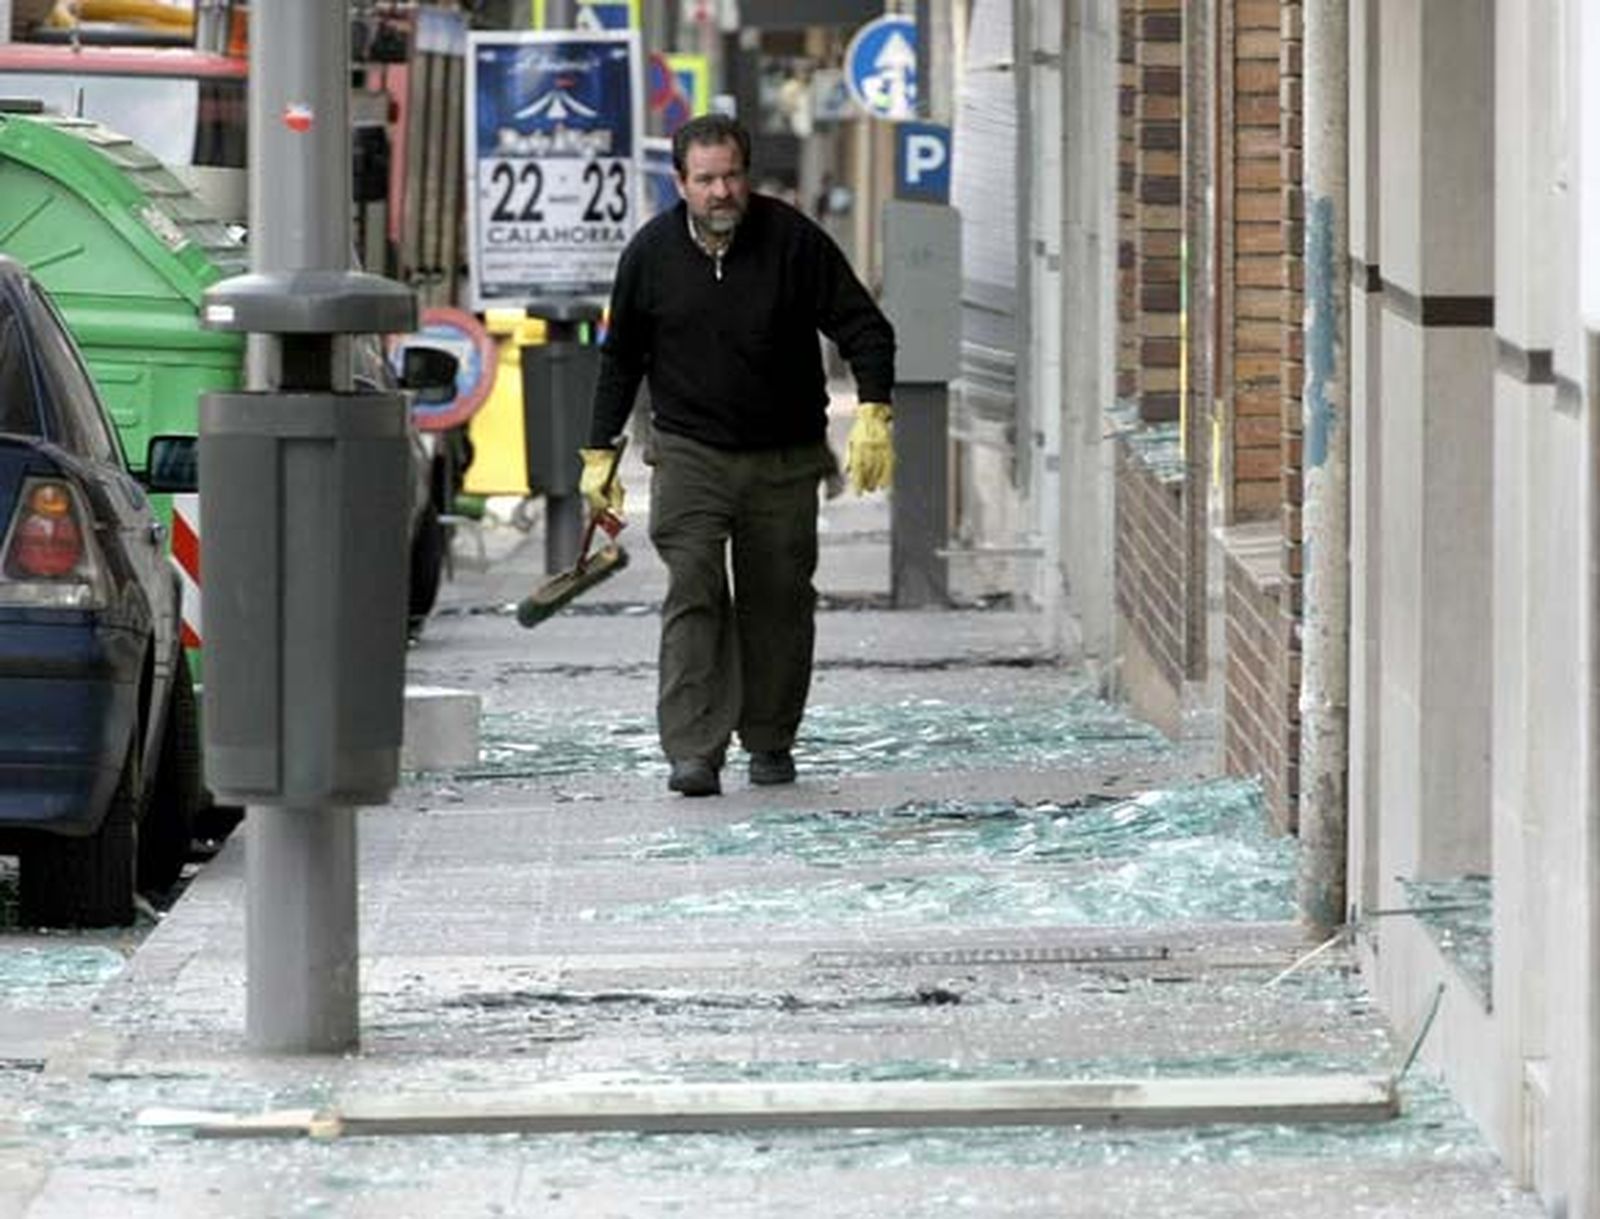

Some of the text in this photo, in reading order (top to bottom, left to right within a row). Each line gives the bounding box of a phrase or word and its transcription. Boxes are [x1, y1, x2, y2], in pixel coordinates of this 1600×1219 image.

[905, 134, 946, 183] P
[490, 161, 628, 223] 22 23
[487, 226, 626, 245] CALAHORRA
